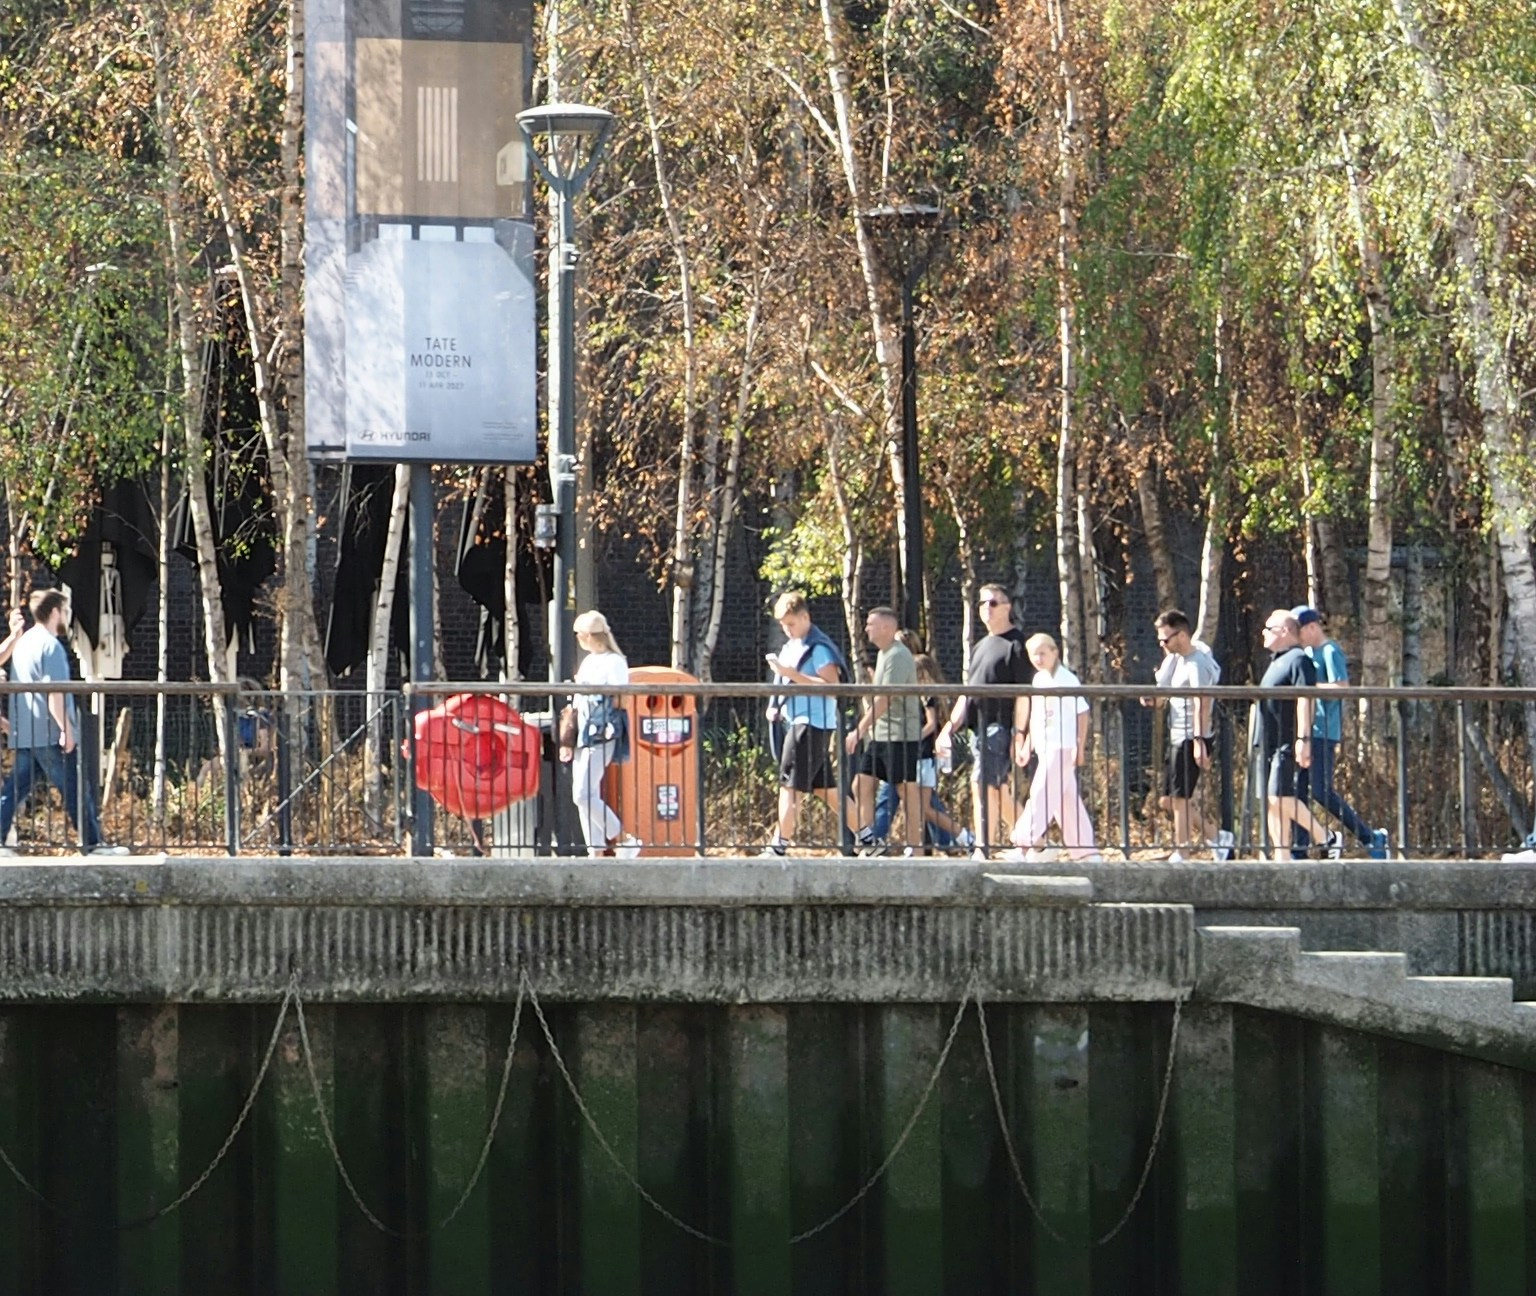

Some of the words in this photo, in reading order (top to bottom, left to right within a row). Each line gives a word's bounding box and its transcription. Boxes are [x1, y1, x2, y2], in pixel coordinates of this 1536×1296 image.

[425, 337, 457, 351] TATE
[411, 354, 472, 368] MODERN
[381, 431, 432, 442] HYUNDAI
